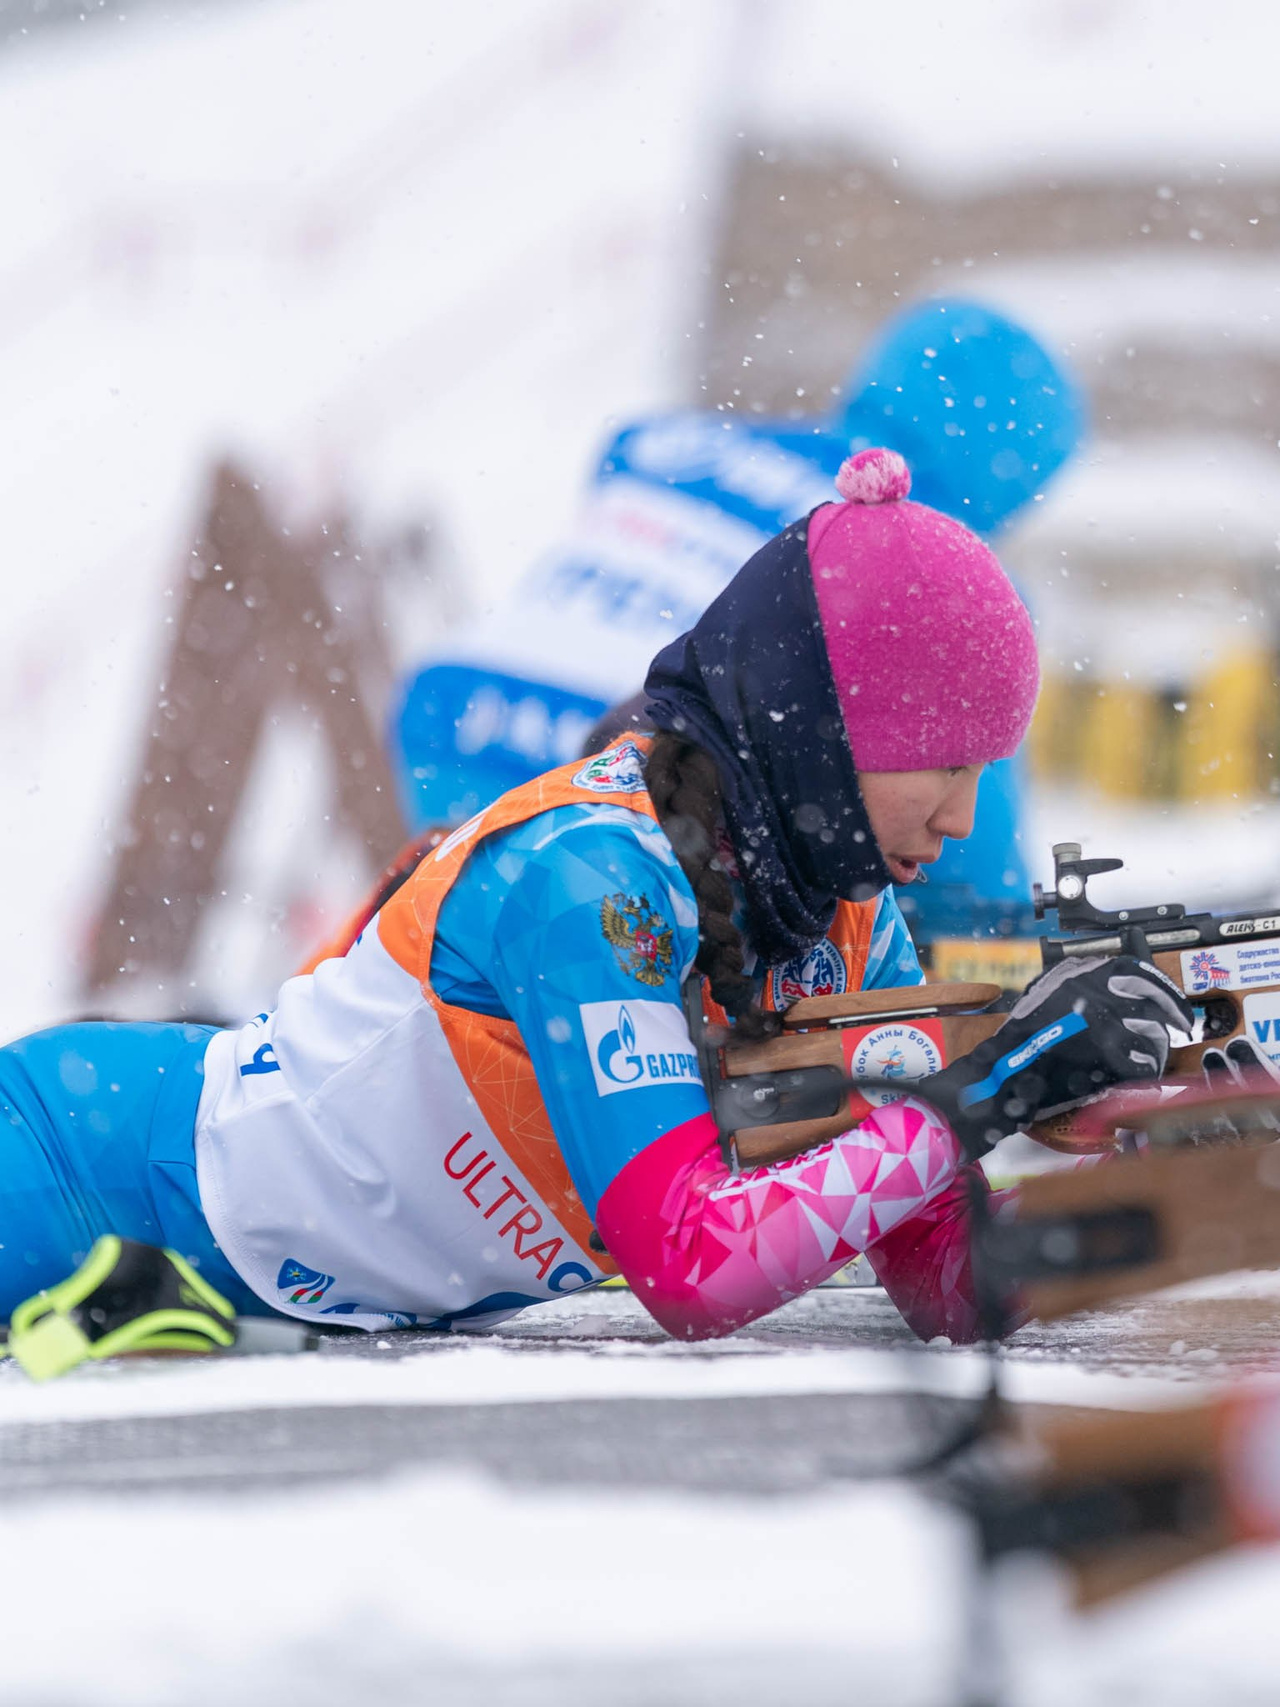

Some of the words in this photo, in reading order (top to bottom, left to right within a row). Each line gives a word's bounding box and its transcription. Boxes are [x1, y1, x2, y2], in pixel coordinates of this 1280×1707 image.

[645, 1052, 701, 1079] GAZPR
[867, 1029, 904, 1047] Анны
[907, 1030, 938, 1076] Богали
